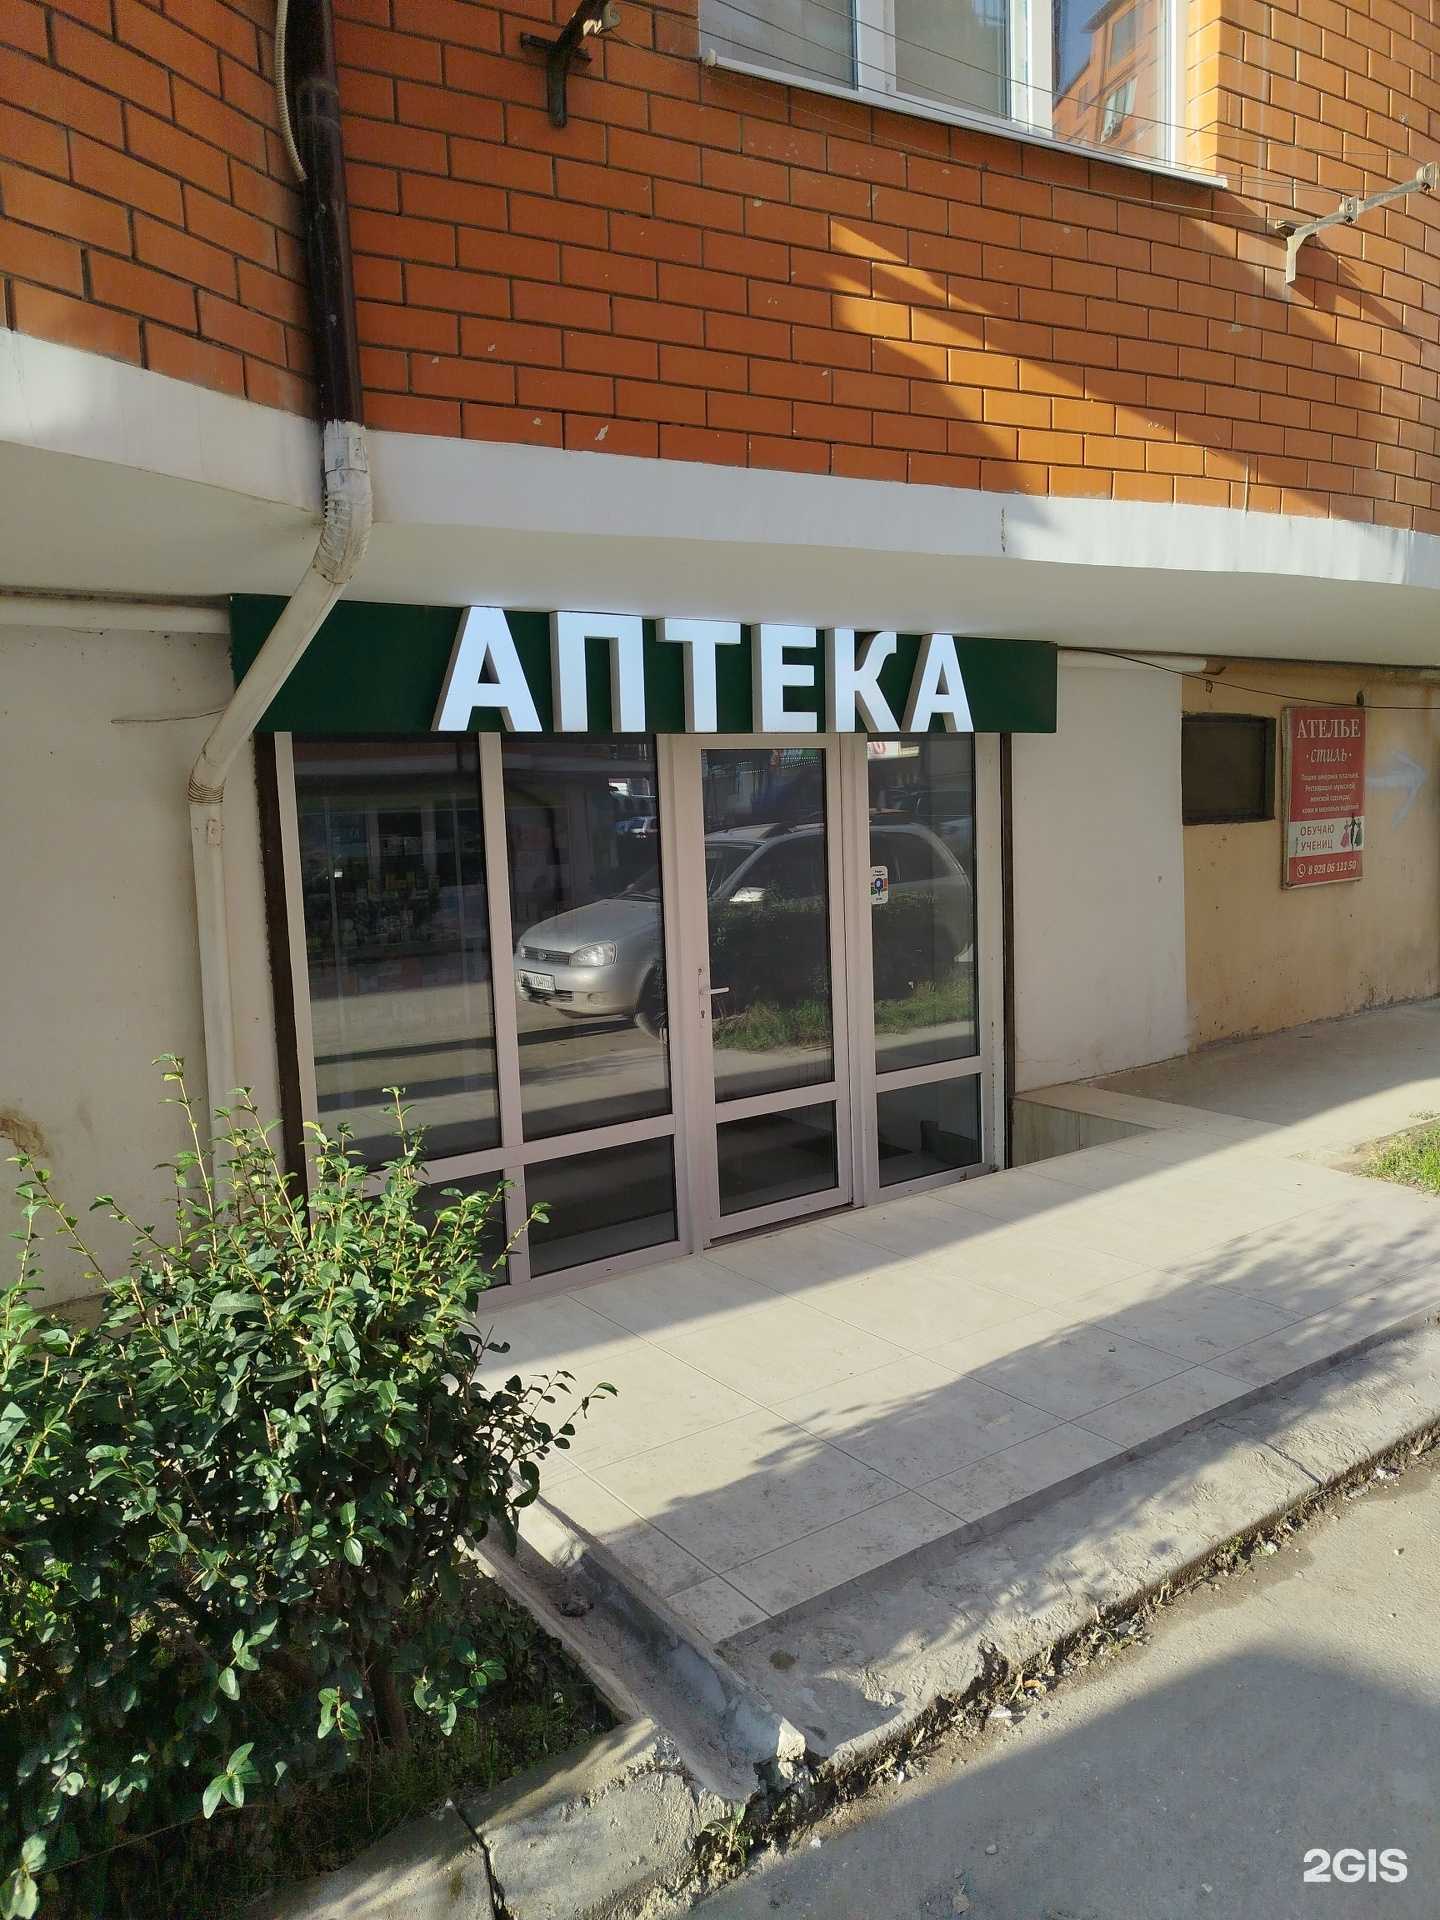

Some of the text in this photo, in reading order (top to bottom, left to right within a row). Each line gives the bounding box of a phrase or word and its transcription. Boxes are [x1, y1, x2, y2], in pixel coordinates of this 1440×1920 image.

[431, 606, 974, 733] АПТЕКА
[1296, 719, 1361, 738] АТЕЛЬЕ
[1300, 823, 1335, 836] ОБУЧАЮ
[1301, 839, 1333, 851] УЧЕНИЦ
